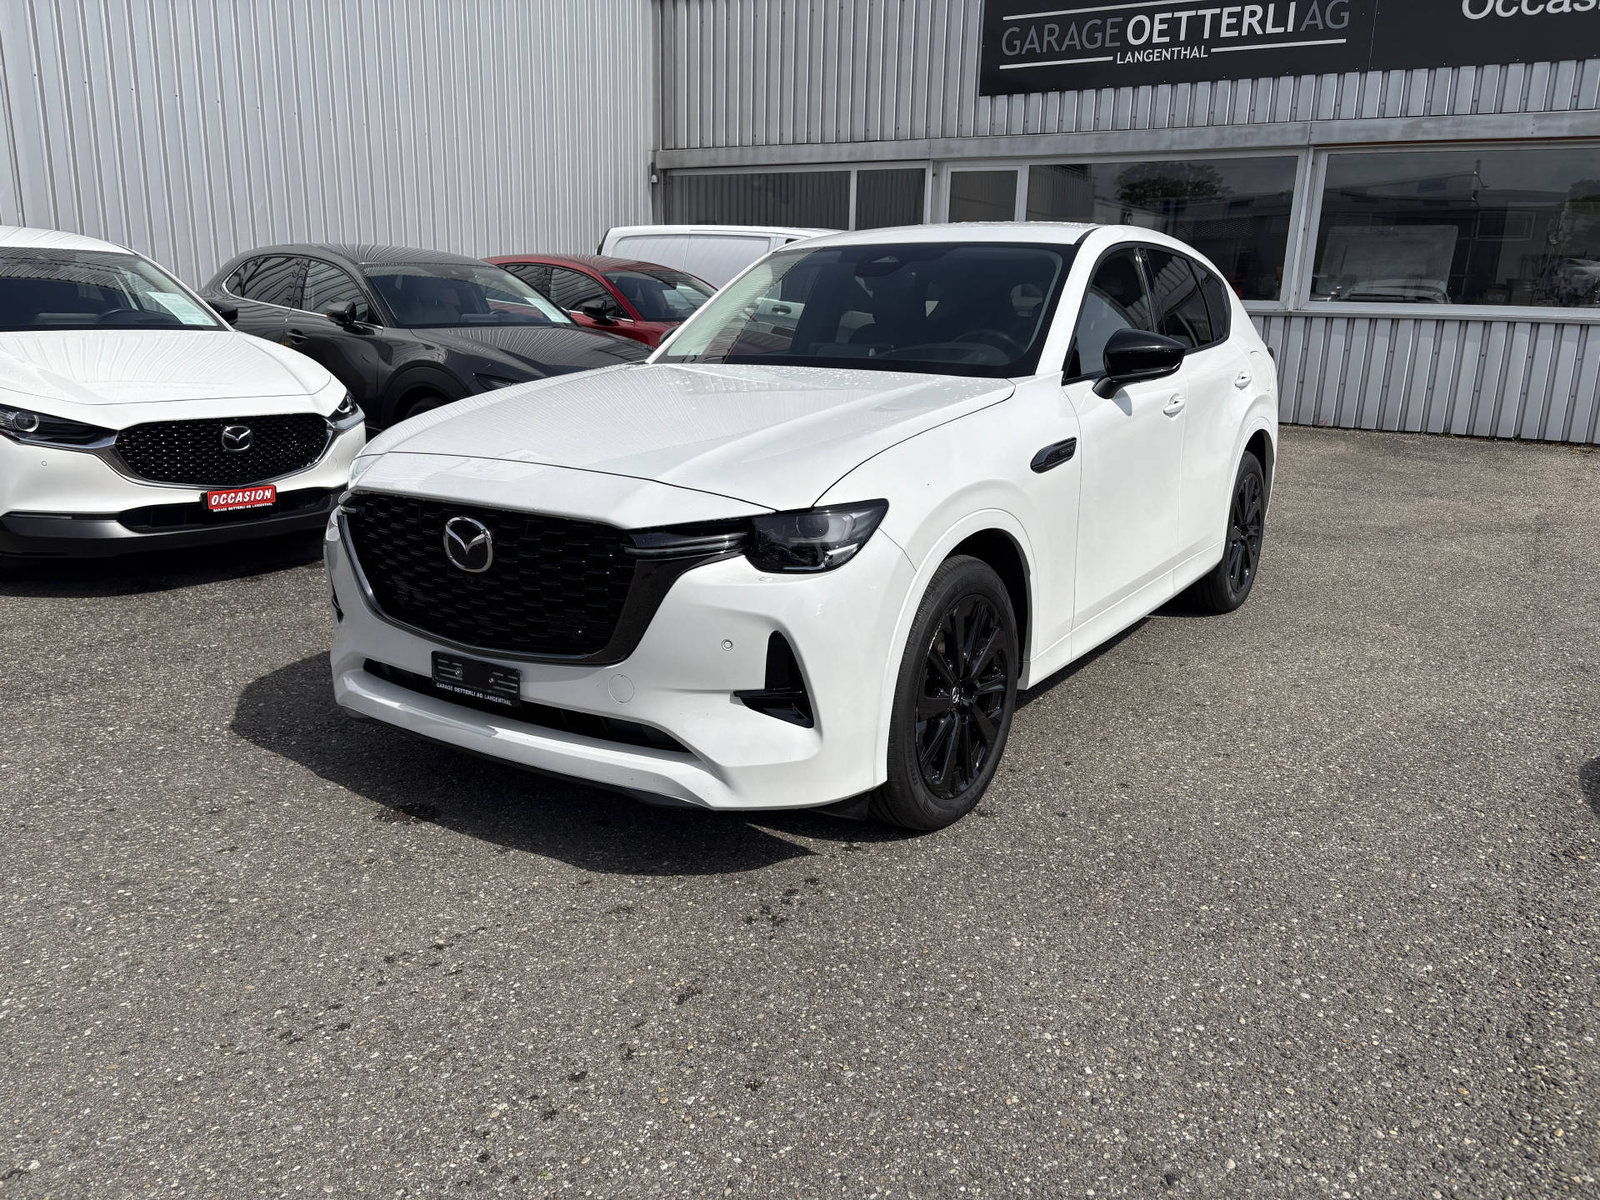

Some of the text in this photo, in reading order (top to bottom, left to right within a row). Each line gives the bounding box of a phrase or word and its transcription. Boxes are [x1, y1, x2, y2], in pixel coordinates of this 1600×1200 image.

[1002, 0, 1350, 56] GARAGE OETTERLI AG
[1116, 45, 1209, 65] LANGENTHAL
[211, 489, 272, 506] OCCASION
[436, 682, 453, 691] GARAGE
[454, 687, 475, 697] OETTERLI
[484, 694, 512, 706] LANGENTHAL
